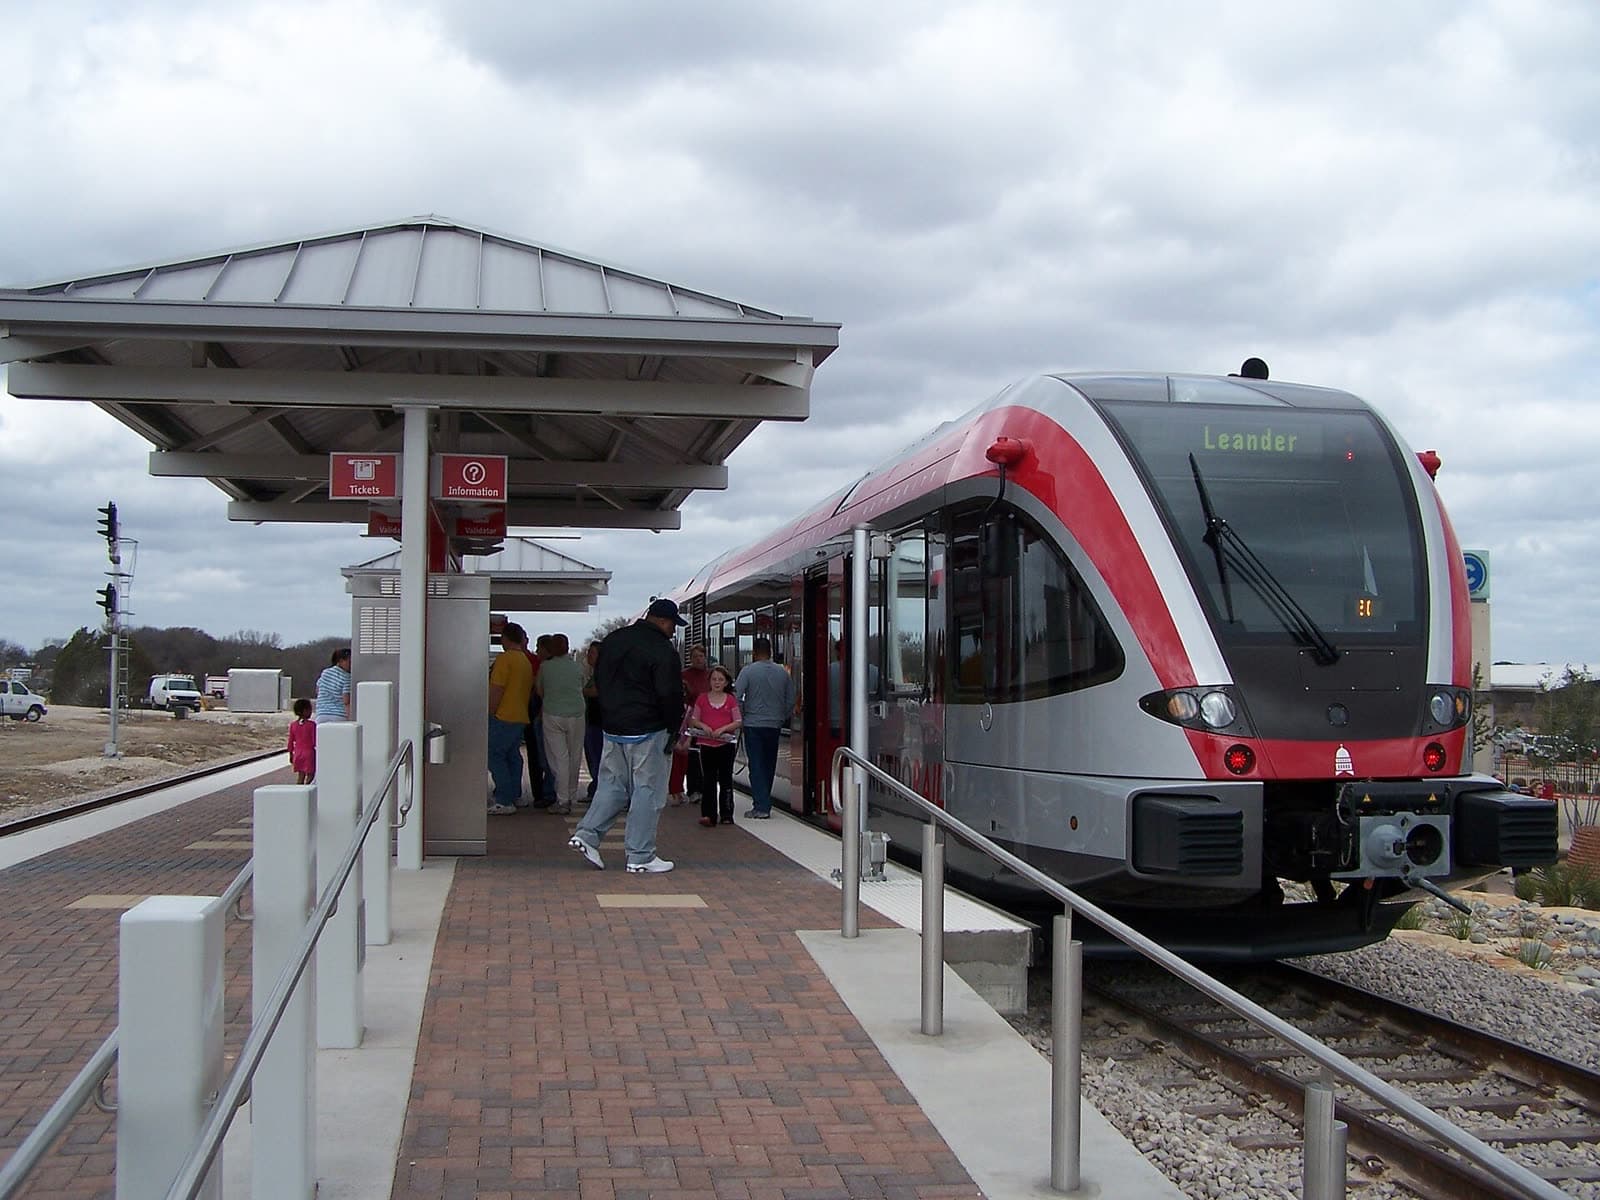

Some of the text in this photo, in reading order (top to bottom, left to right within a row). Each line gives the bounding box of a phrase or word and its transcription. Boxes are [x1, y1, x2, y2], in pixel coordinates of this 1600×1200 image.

[1204, 425, 1298, 452] Leander
[349, 484, 380, 495] Tickets
[448, 485, 499, 497] Information
